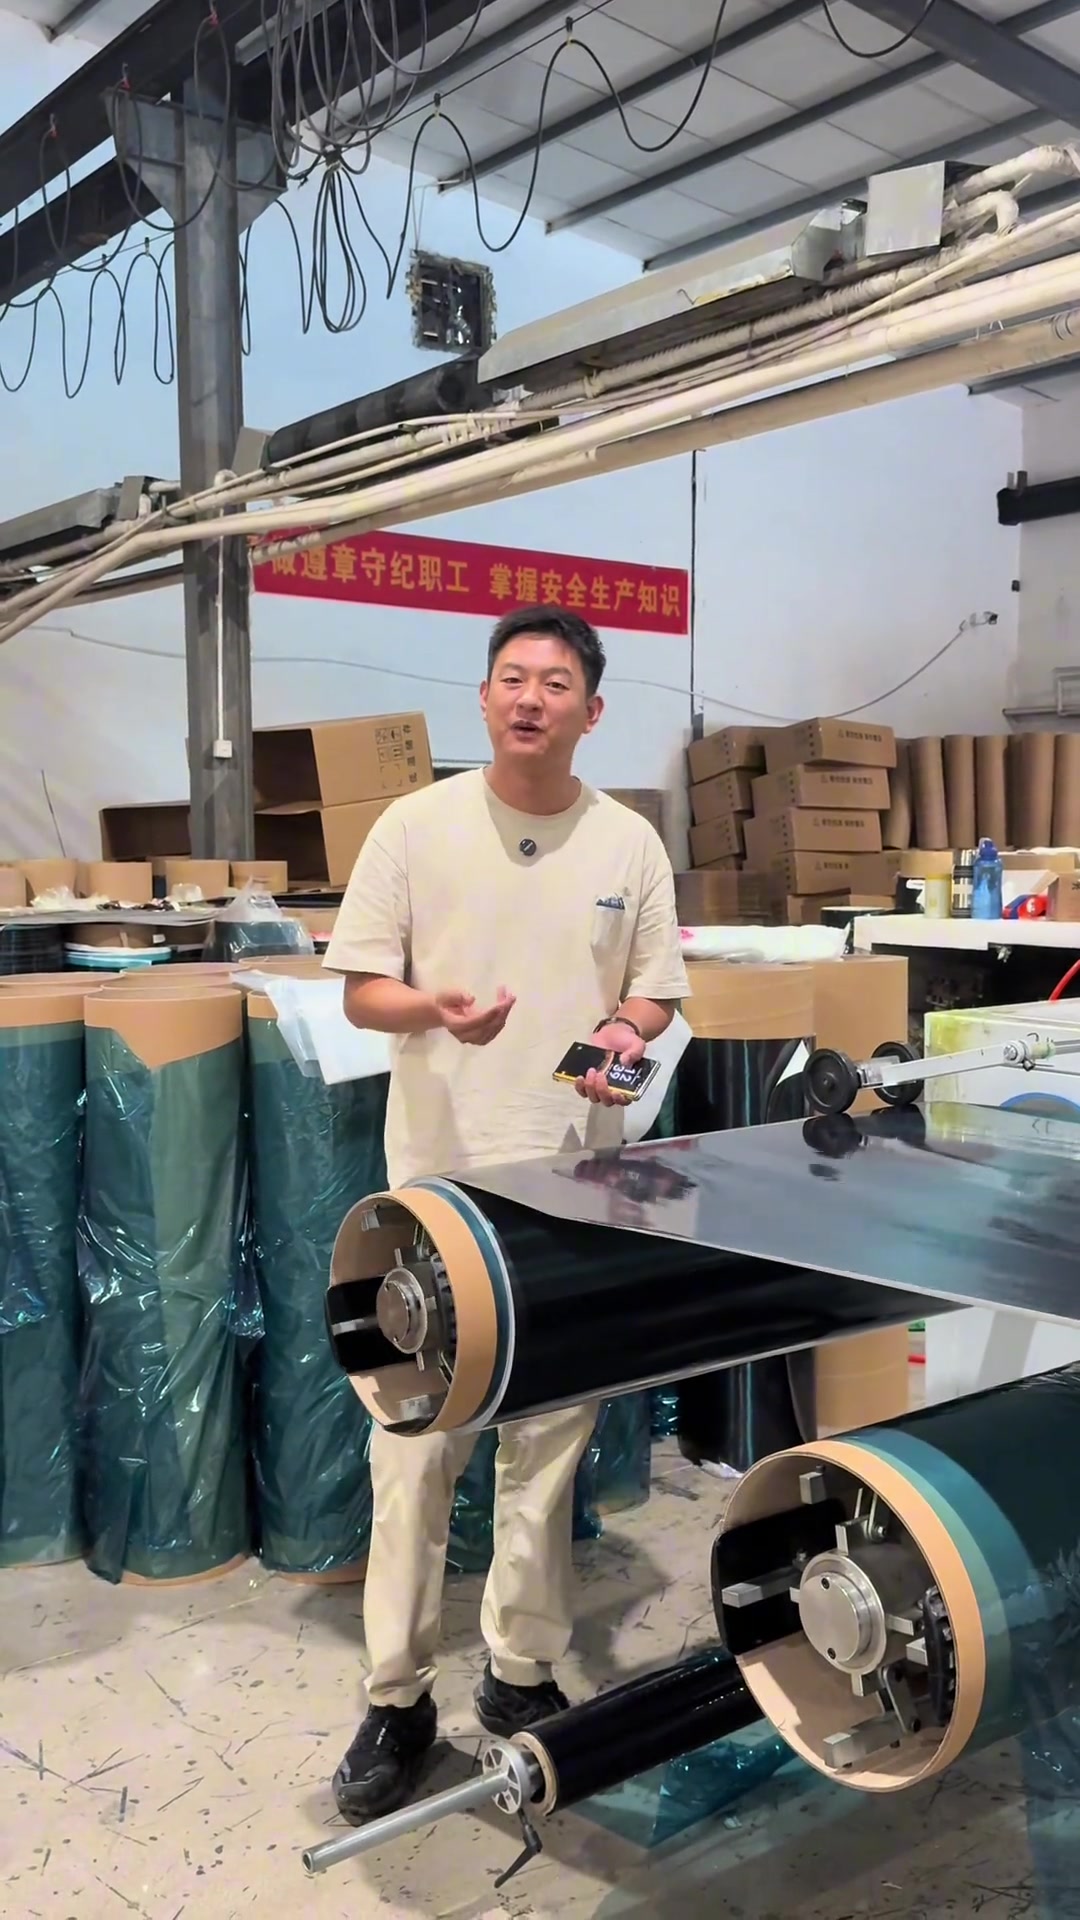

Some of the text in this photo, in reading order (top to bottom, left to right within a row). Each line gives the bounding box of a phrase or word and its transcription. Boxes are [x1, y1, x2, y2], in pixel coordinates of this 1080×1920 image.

[489, 563, 680, 617] 掌握安全生产知识
[609, 1064, 624, 1080] 39
[619, 1068, 636, 1082] 12
